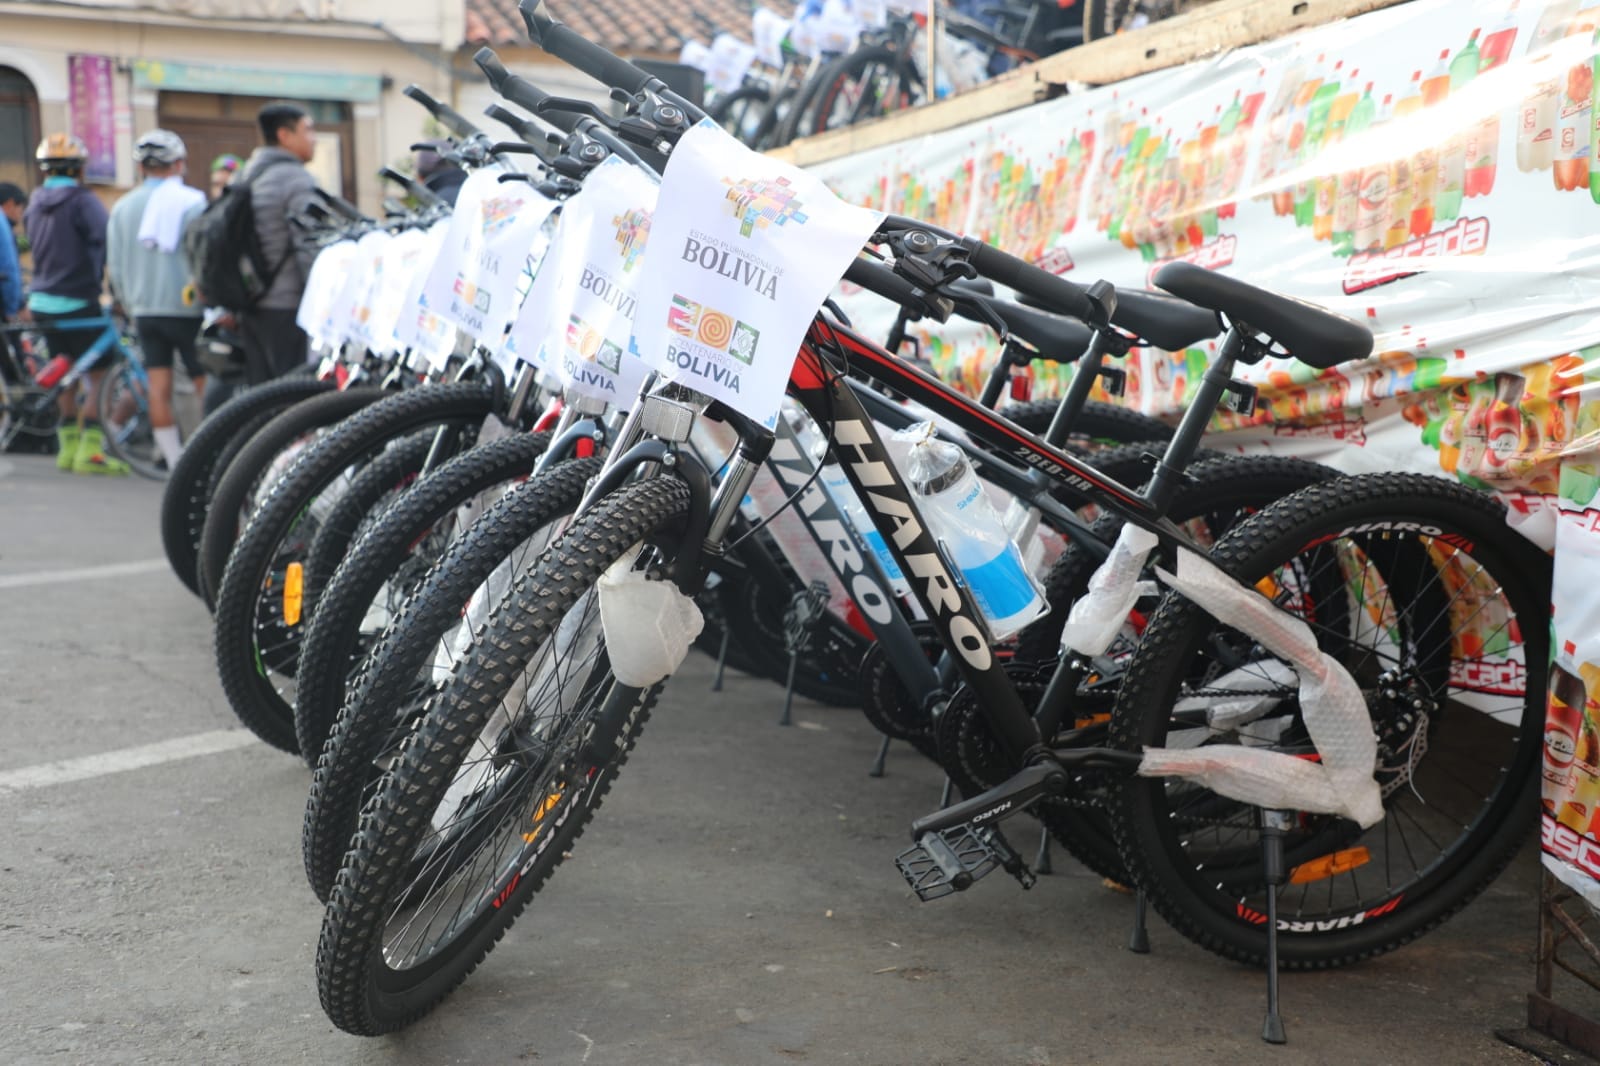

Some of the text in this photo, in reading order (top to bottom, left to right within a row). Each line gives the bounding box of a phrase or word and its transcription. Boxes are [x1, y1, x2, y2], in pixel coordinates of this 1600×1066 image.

[689, 229, 719, 246] ESTADO
[682, 236, 778, 300] BOLIVIA
[579, 268, 637, 321] BOLIVI
[666, 344, 740, 393] BOLIVIA
[671, 335, 732, 367] CENTENARIO
[827, 419, 992, 671] HARO
[1338, 521, 1443, 537] HARO
[972, 800, 1011, 823] HARO
